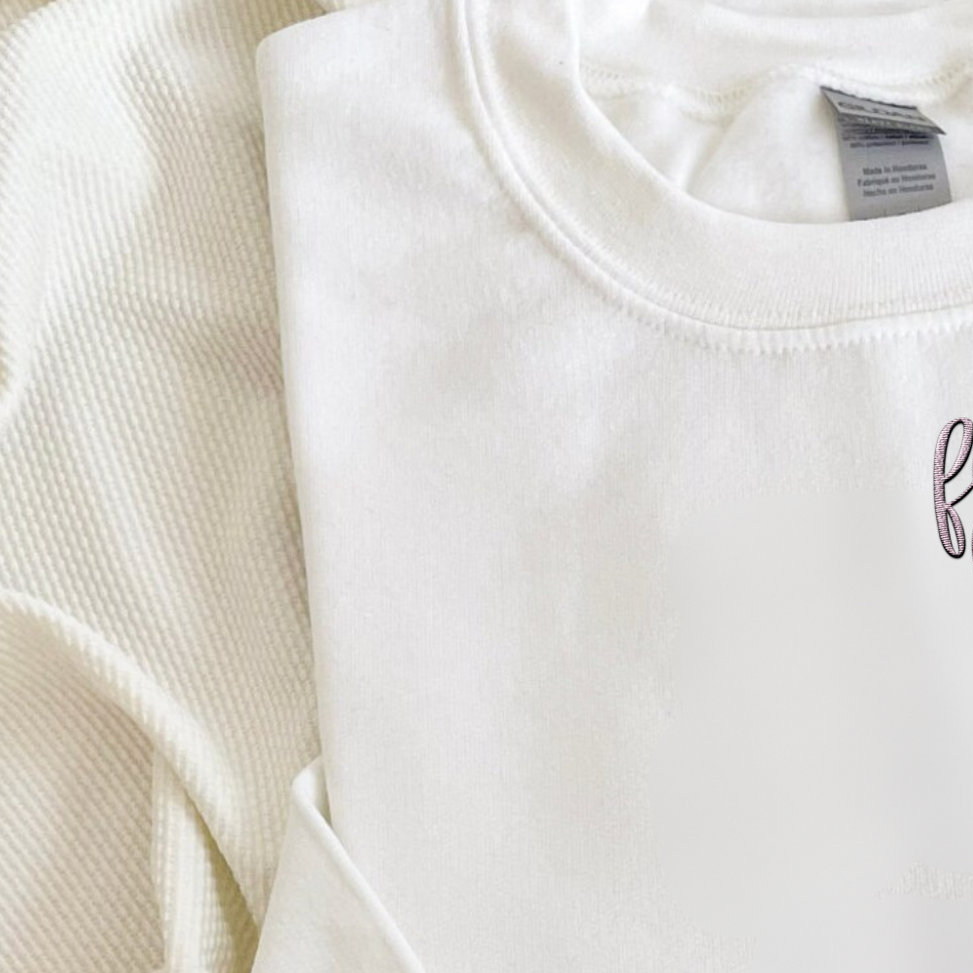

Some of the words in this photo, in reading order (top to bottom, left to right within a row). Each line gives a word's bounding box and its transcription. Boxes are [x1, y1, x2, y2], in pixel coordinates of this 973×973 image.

[862, 166, 882, 175] Made
[883, 165, 892, 173] in
[892, 163, 927, 172] Honduras
[901, 173, 936, 181] Honduras
[899, 182, 934, 192] Honduras
